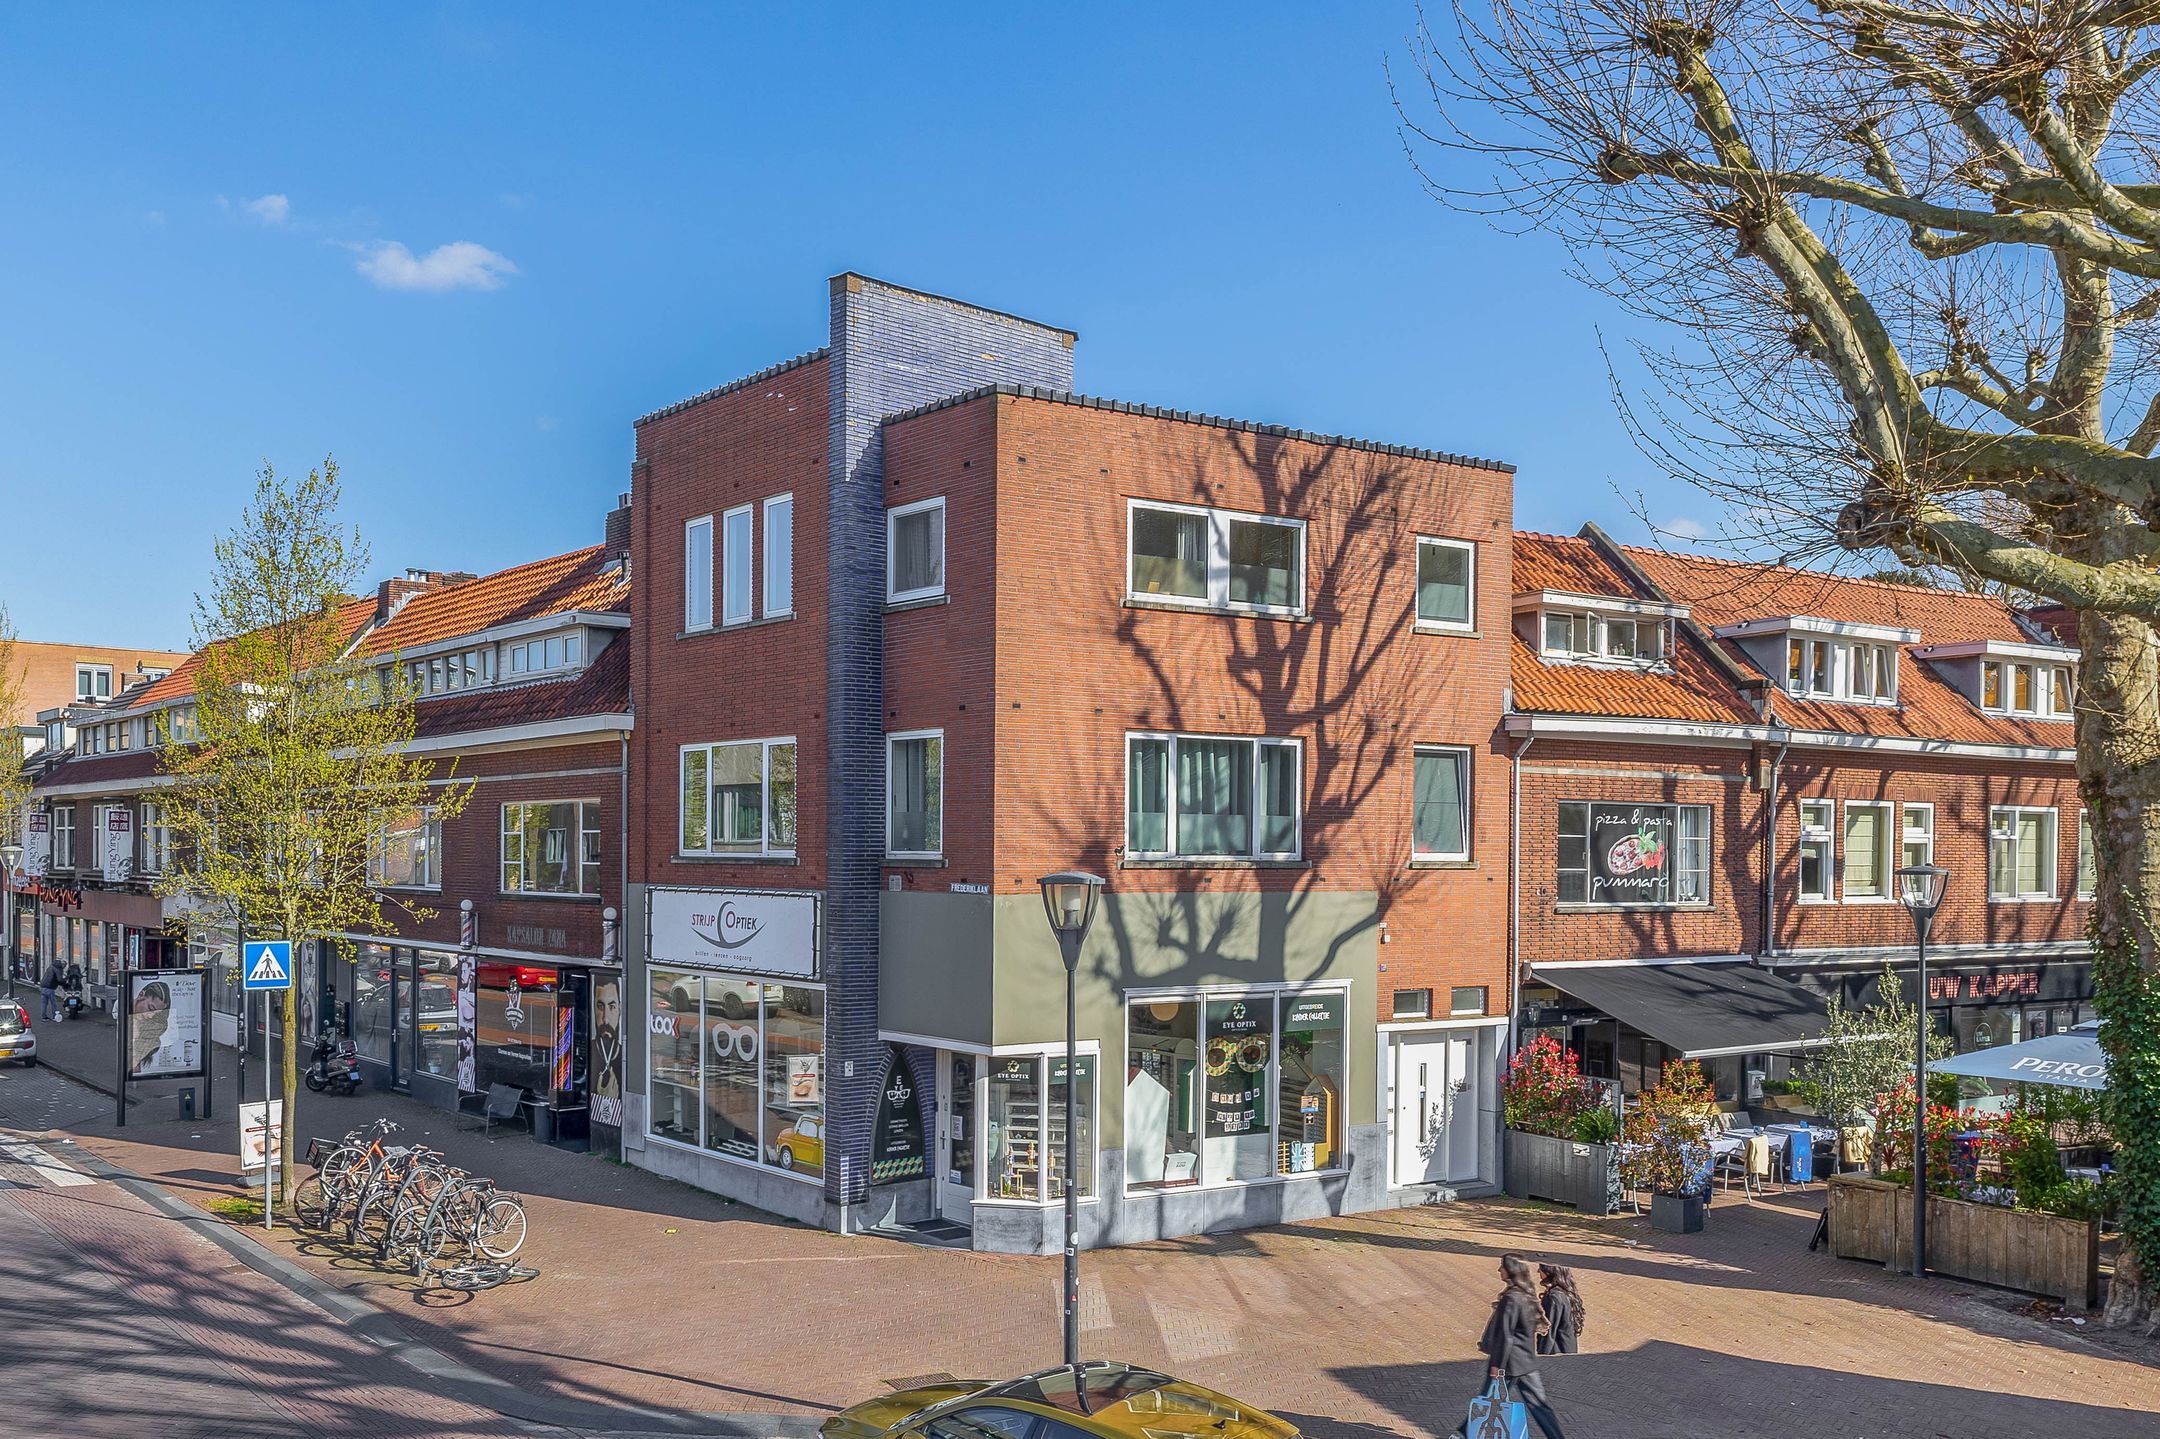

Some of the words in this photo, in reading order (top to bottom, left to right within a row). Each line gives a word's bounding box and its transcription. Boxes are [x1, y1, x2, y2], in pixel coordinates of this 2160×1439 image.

[1595, 812, 1627, 832] pizza
[1630, 808, 1640, 825] &
[1643, 811, 1673, 832] pasta
[691, 913, 716, 927] STRIJP
[726, 910, 758, 931] OPTIEK
[1929, 976, 1962, 999] UW
[1969, 972, 2039, 998] KAPPER
[1222, 1021, 1235, 1029] EYE
[1236, 1020, 1257, 1028] OPTIX
[2038, 1074, 2088, 1084] ITALIA
